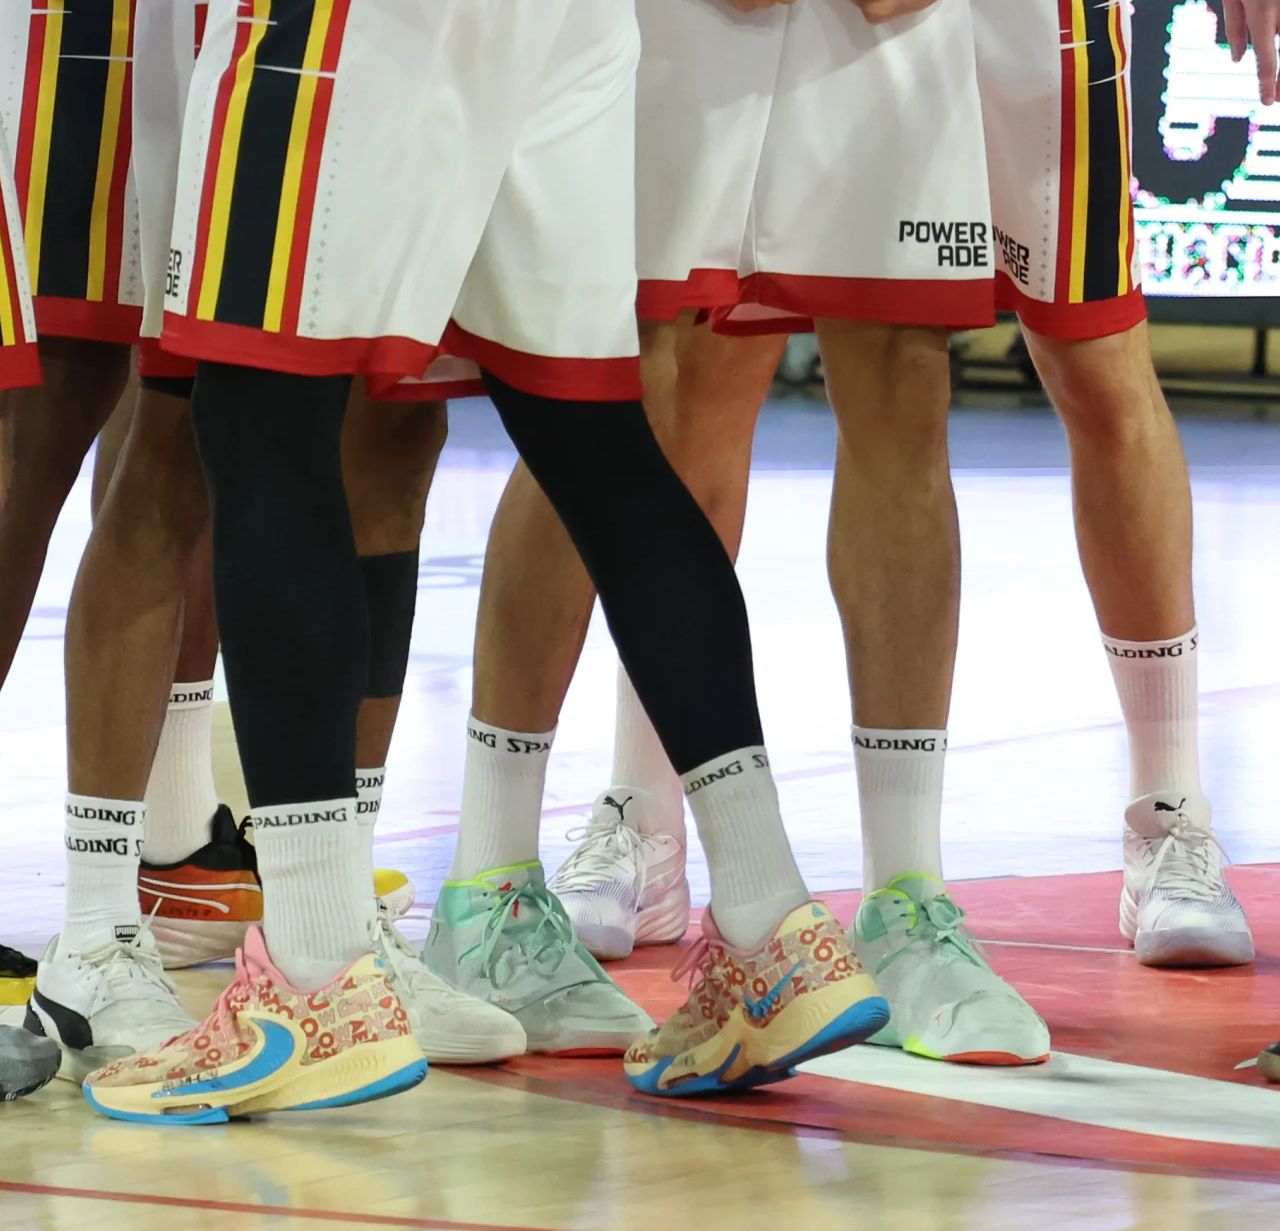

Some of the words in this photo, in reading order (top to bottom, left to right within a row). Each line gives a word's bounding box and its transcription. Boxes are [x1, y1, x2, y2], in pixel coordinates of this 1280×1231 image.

[898, 220, 988, 244] POWER
[937, 245, 988, 267] ADE
[1002, 249, 1030, 286] ADE
